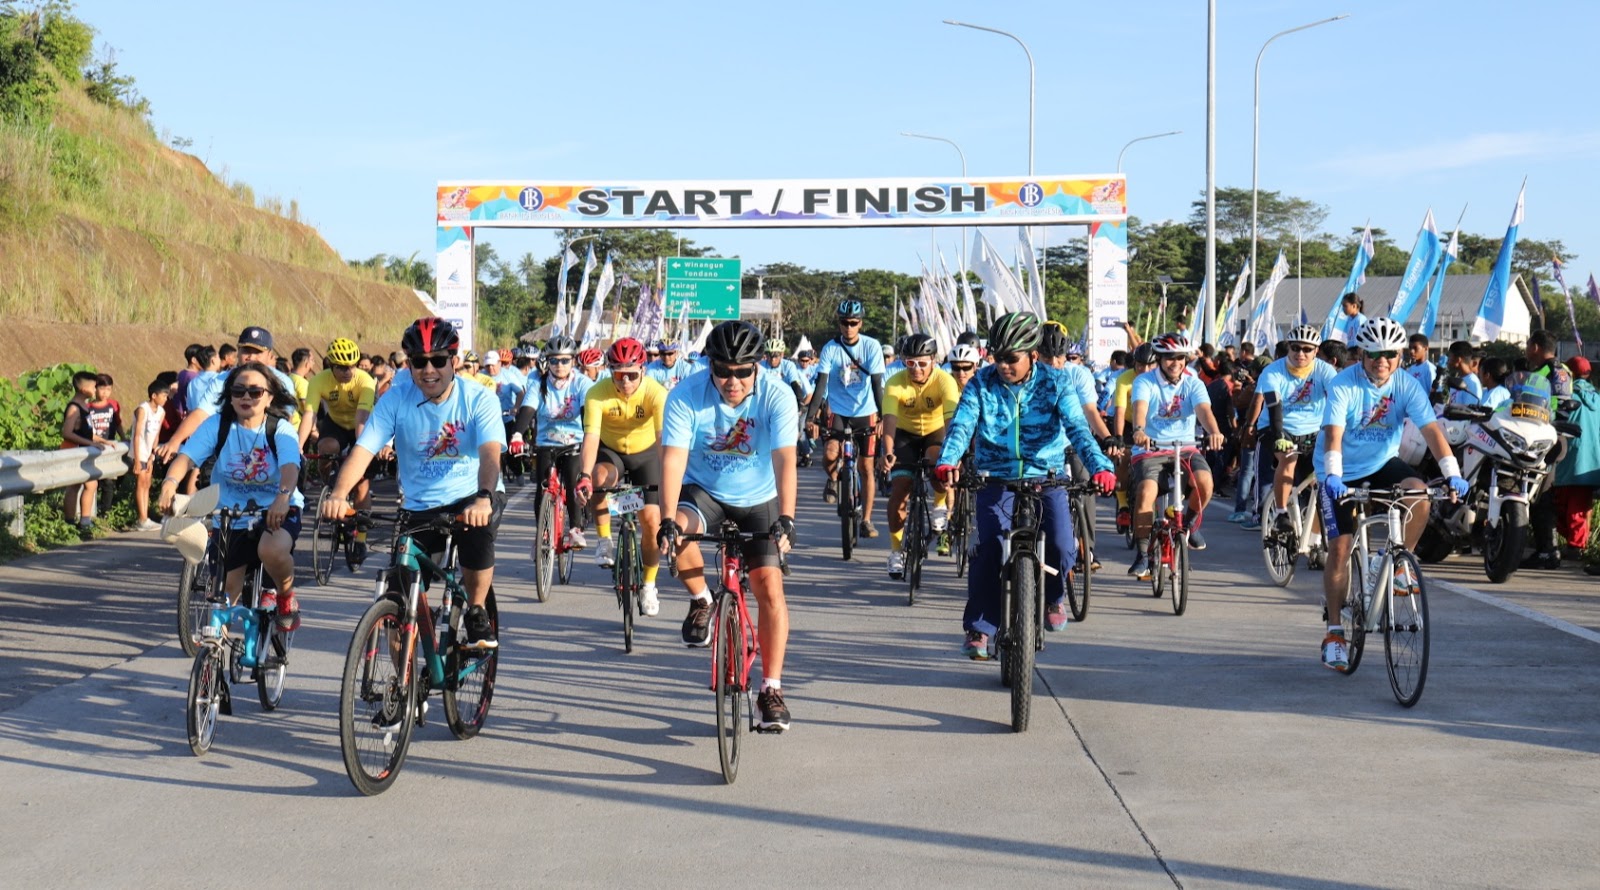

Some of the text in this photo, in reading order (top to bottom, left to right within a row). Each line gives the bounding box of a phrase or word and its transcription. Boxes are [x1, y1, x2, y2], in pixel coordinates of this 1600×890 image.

[577, 189, 753, 216] START
[802, 186, 987, 214] FINISH
[684, 261, 724, 270] Winangun
[684, 270, 719, 278] Tondano
[670, 282, 697, 290] Kairagi
[670, 290, 698, 298] Maumbi
[1106, 339, 1121, 347] BNI
[1475, 428, 1497, 449] POLISI
